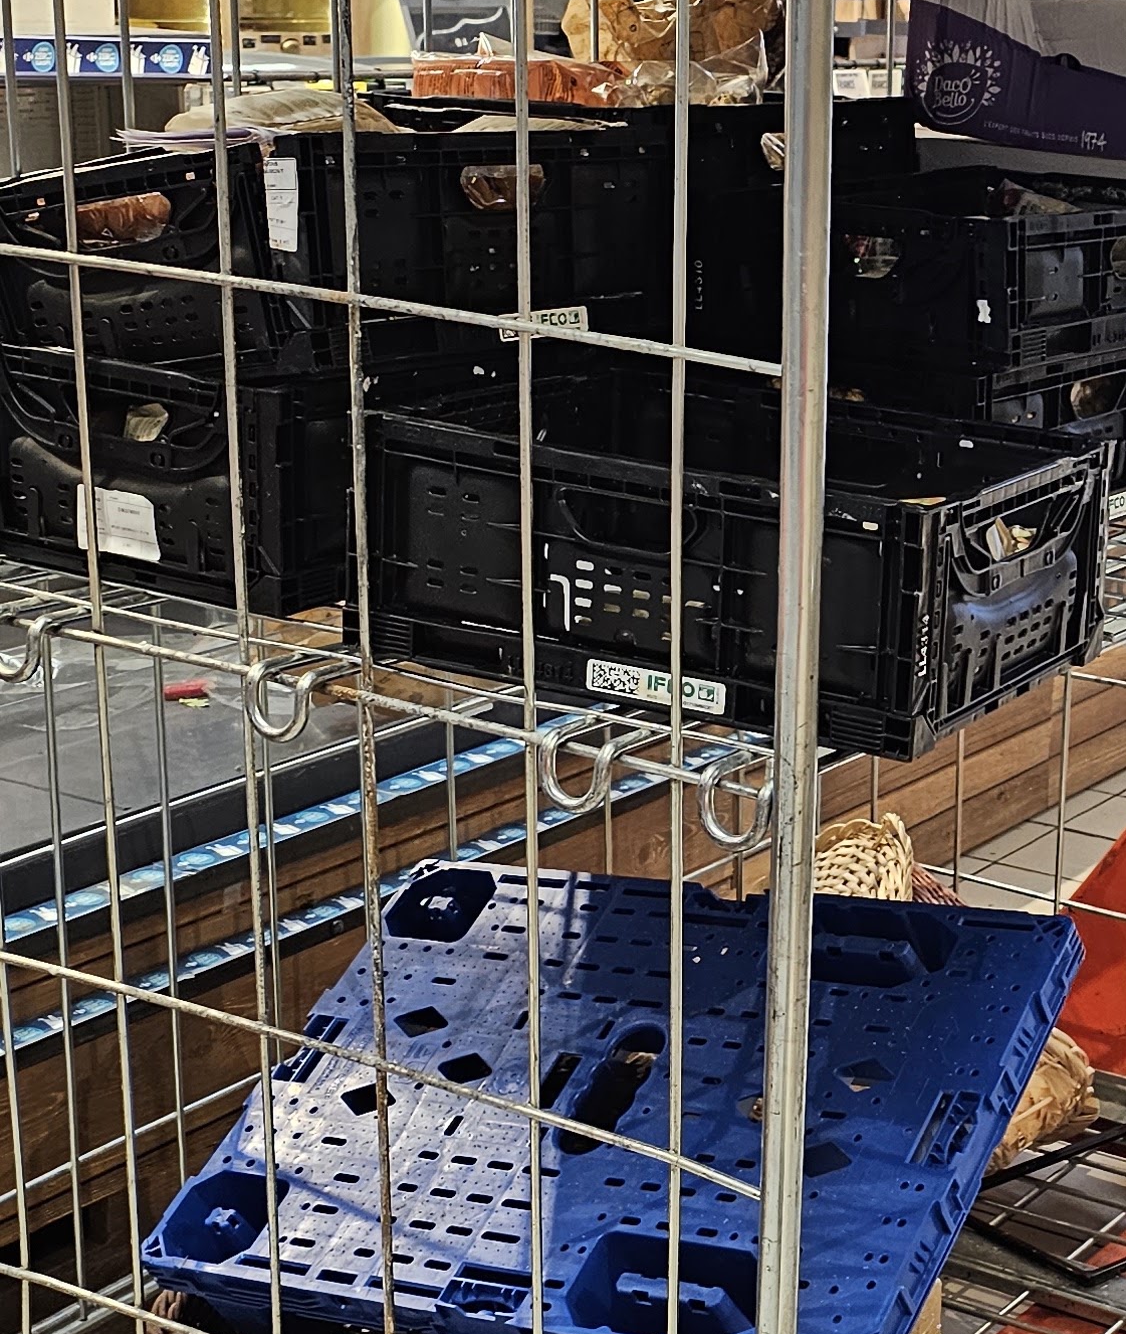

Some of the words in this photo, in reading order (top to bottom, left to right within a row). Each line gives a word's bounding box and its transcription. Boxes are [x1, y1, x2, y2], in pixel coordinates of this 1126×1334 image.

[933, 75, 972, 94] Daco
[933, 92, 967, 109] Bello
[1081, 130, 1107, 152] 1974
[1109, 495, 1125, 509] FCO
[917, 614, 930, 677] LL4314
